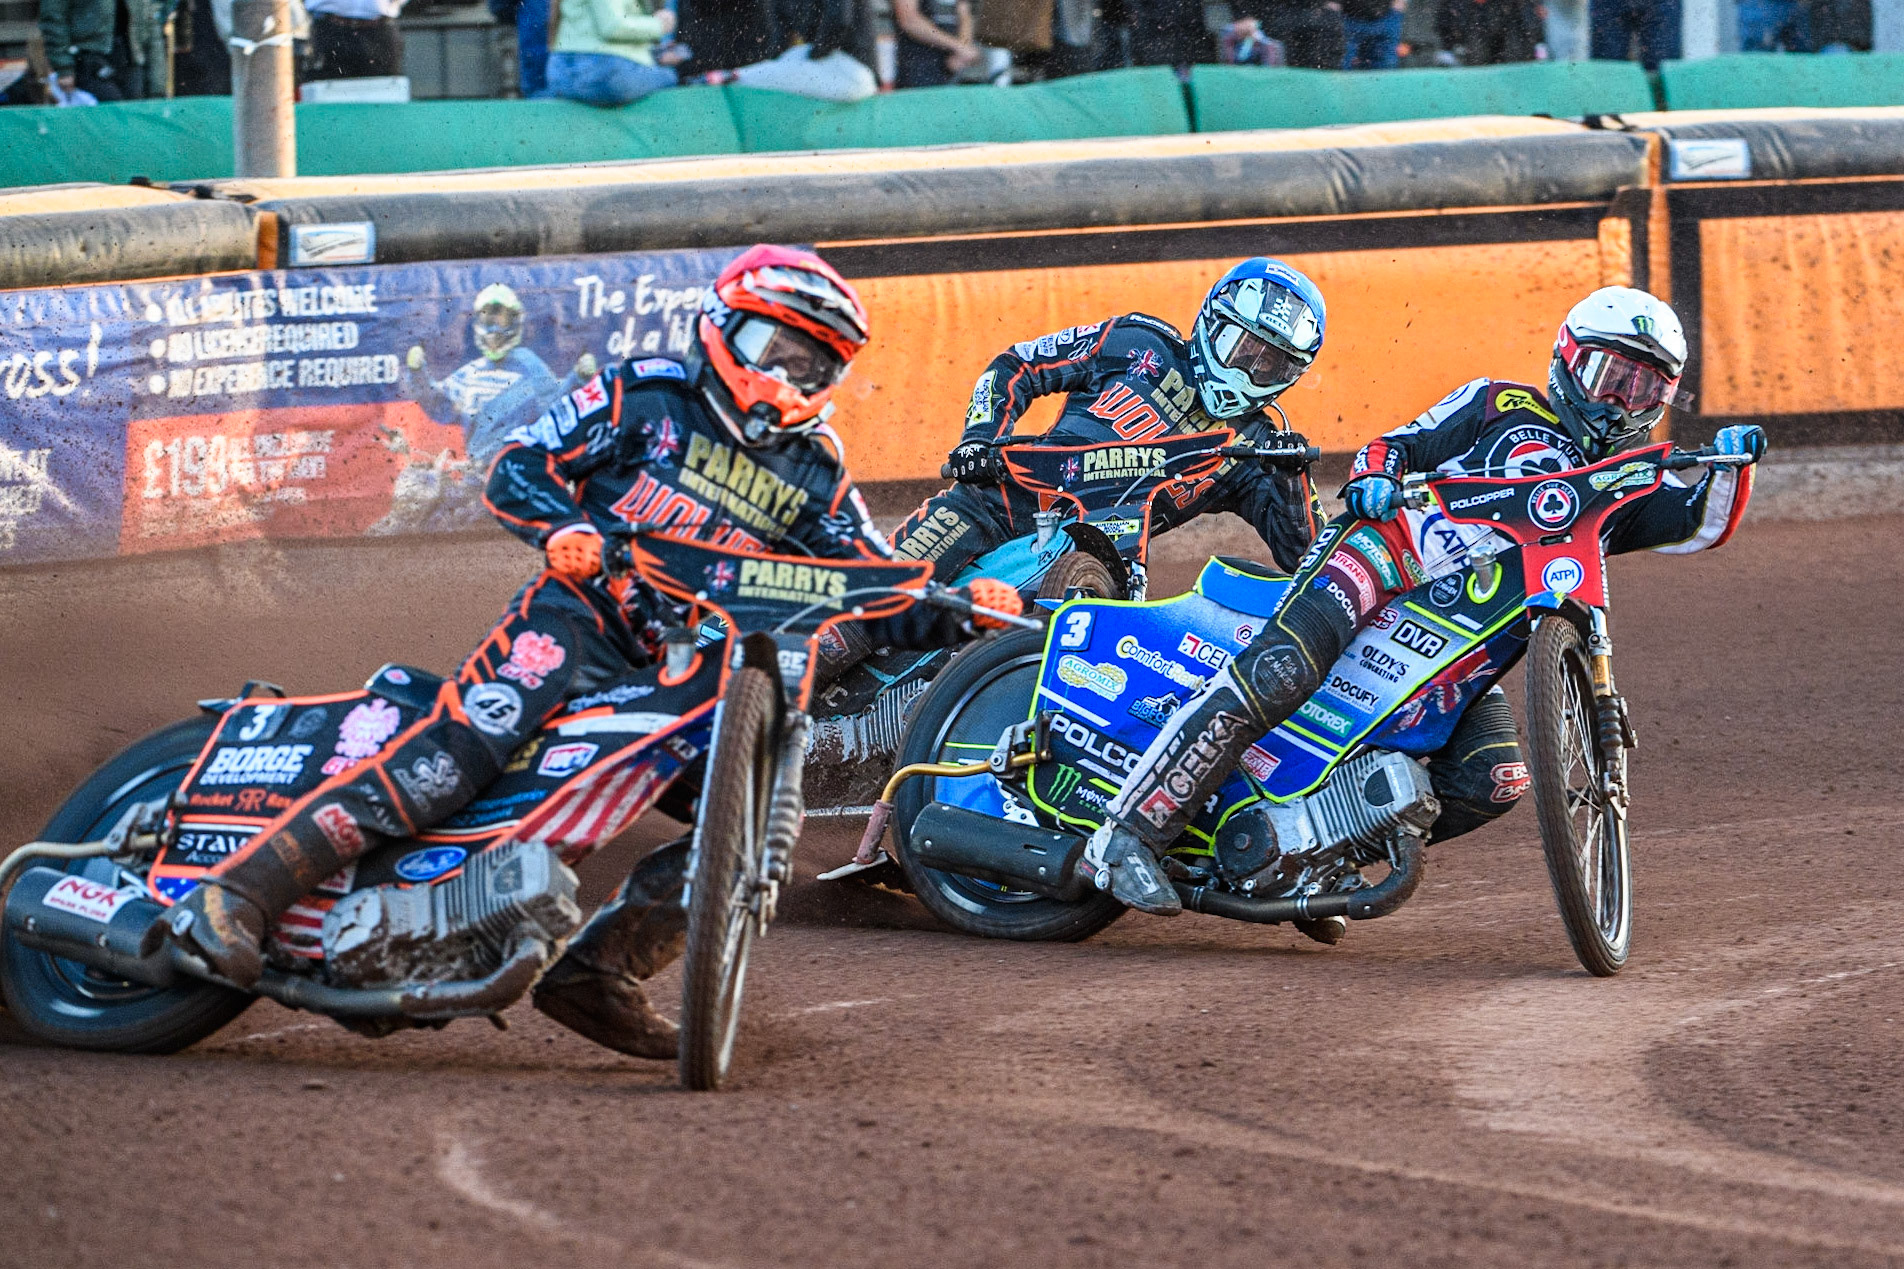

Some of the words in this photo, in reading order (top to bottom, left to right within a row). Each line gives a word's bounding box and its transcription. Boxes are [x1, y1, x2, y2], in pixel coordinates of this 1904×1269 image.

[280, 284, 378, 316] WELCOME
[573, 275, 626, 318] The
[267, 321, 359, 354] REQUIRED
[642, 330, 661, 352] a
[298, 354, 399, 388] REQUIRED
[1084, 447, 1167, 472] PARRYS
[1509, 430, 1550, 444] BELLE
[1557, 440, 1580, 465] VUE
[684, 431, 809, 526] PARRYS
[1450, 488, 1515, 510] POLCOPPER
[1301, 528, 1338, 569] DVR
[739, 559, 848, 597] PARRYS
[1334, 553, 1366, 584] TRANS
[1550, 569, 1575, 582] ATPI
[1060, 612, 1091, 647] 3
[1395, 622, 1443, 657] DVR
[1065, 659, 1119, 691] AGROMIX
[1360, 659, 1399, 683] CONCRETING
[1362, 645, 1409, 676] OLDY'S
[1331, 676, 1379, 706] DOCUFY
[239, 704, 277, 741] 3
[1299, 700, 1352, 734] OTOREX
[206, 744, 314, 774] BORGE
[199, 771, 299, 785] DEVELOPMENT
[58, 880, 119, 907] NGK
